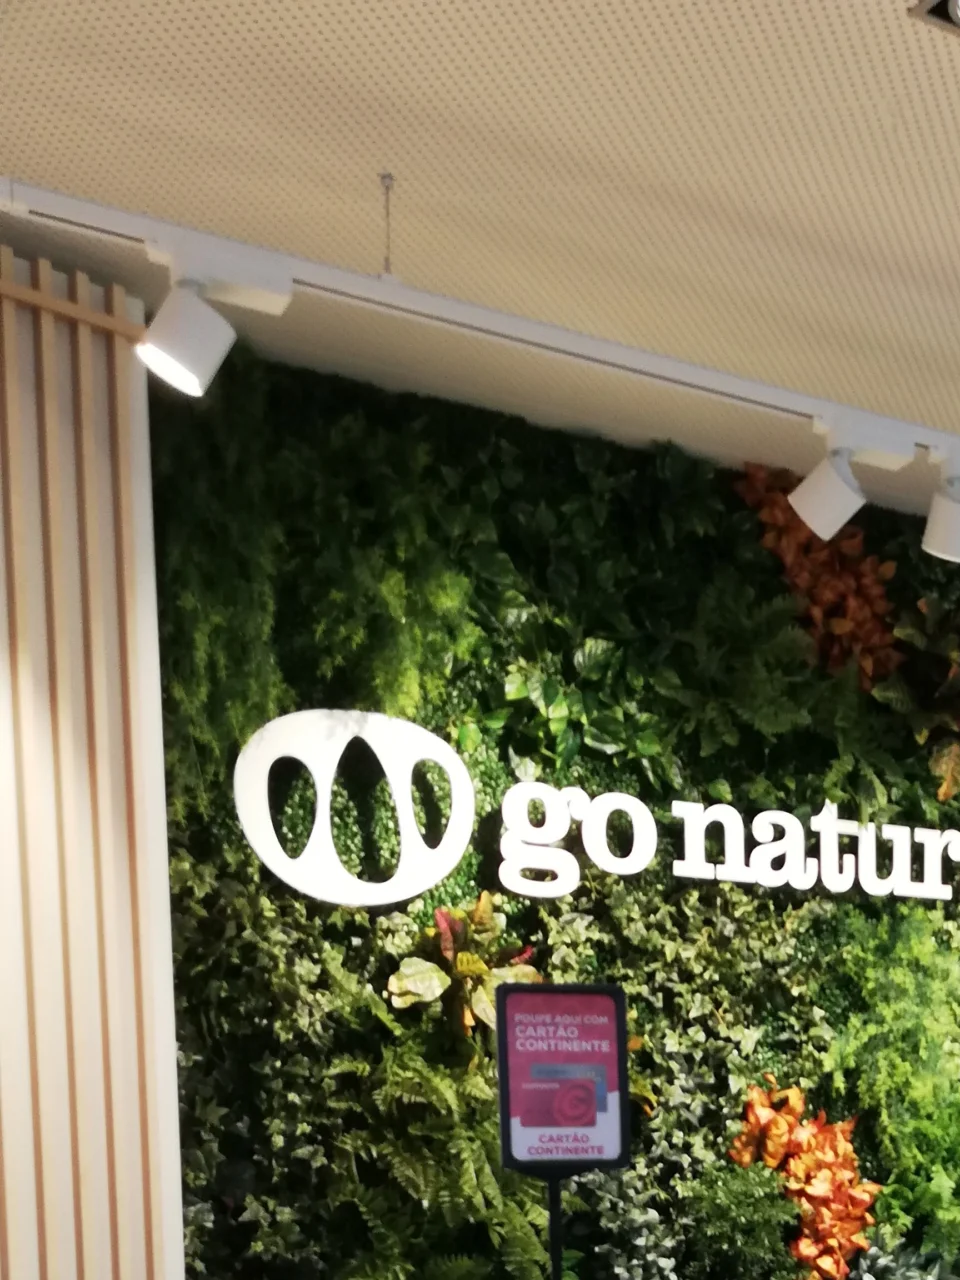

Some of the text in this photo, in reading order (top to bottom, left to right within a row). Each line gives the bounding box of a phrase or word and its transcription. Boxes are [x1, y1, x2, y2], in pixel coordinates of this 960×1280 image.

[499, 780, 657, 899] go
[515, 1025, 578, 1038] CARTÃO
[515, 1039, 610, 1053] CONTINENTE
[538, 1132, 590, 1144] CARTÃO
[527, 1145, 604, 1156] CONTINENTE
